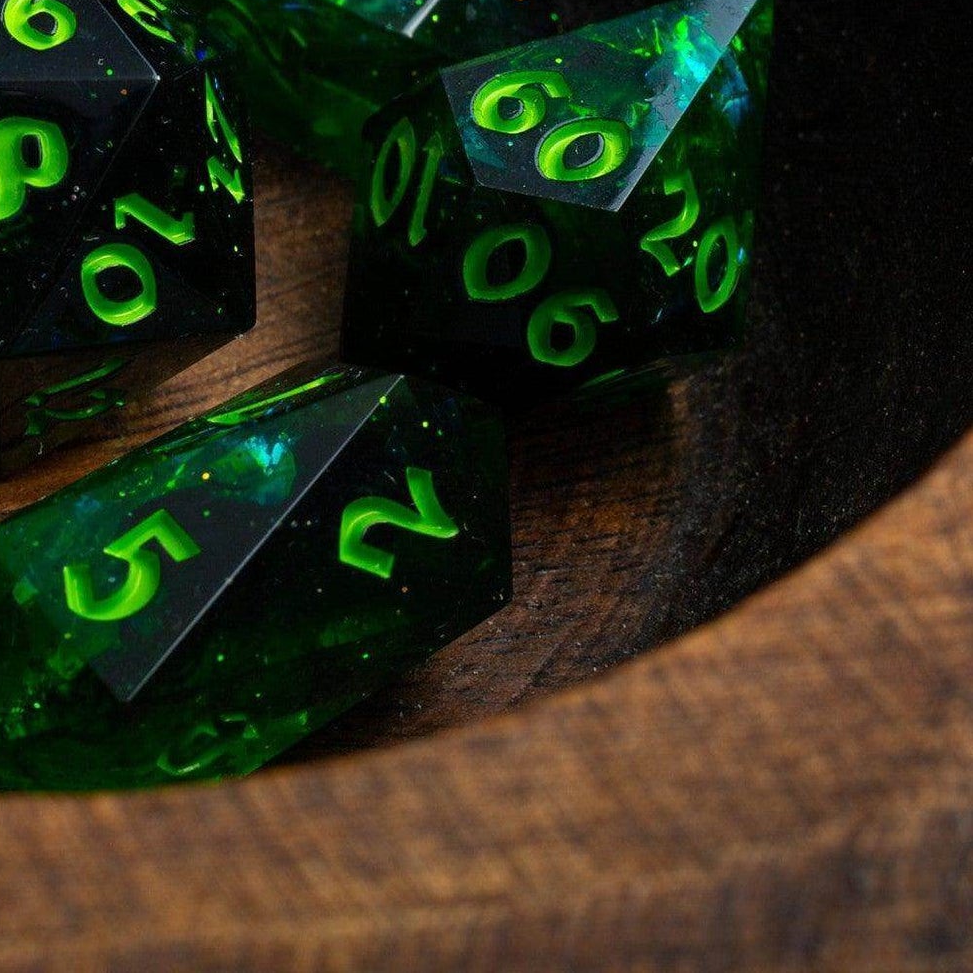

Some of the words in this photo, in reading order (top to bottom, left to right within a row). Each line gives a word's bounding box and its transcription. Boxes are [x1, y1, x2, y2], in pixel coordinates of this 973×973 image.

[471, 70, 632, 182] 60
[80, 192, 195, 327] 10
[640, 169, 741, 314] 20
[63, 509, 201, 622] 5
[339, 467, 460, 579] 2
